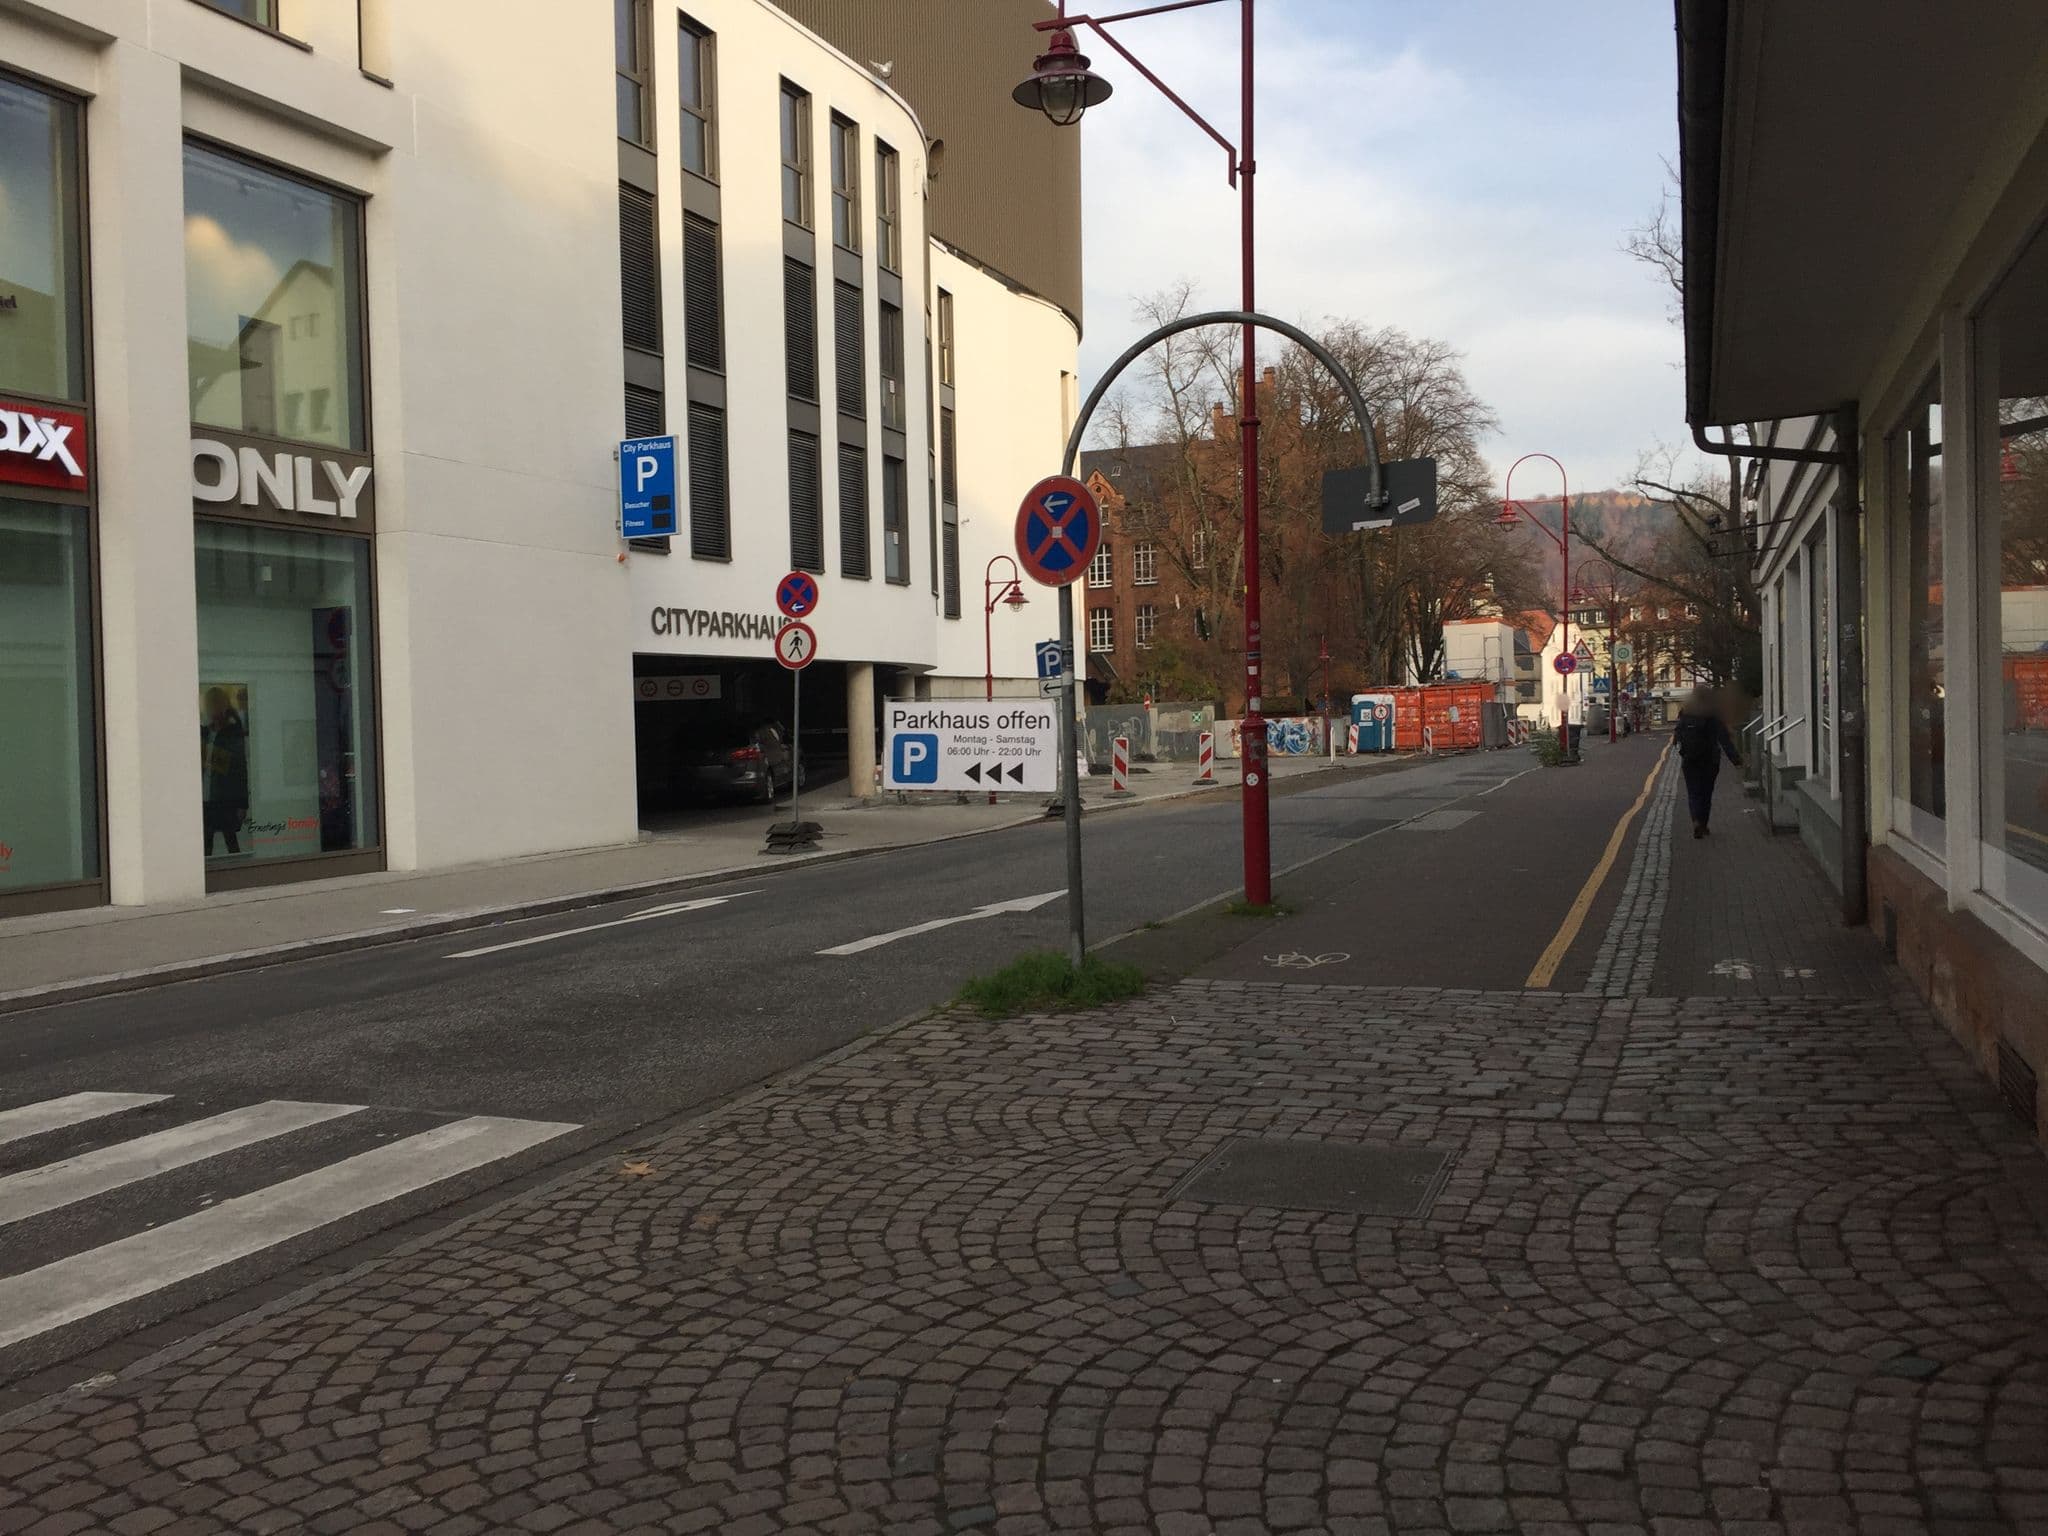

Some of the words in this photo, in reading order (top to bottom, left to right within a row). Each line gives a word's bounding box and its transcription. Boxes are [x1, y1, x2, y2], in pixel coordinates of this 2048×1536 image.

[623, 444, 637, 454] City
[638, 441, 671, 451] Parkhaus
[191, 438, 372, 518] ONLY
[637, 455, 658, 492] P
[1044, 650, 1060, 676] P
[893, 710, 989, 729] Parkhaus
[997, 710, 1050, 729] offen
[953, 735, 987, 745] Montag
[996, 735, 1036, 745] Samstag
[903, 741, 927, 776] P
[947, 747, 971, 756] 06:00
[974, 747, 989, 756] Uhr
[998, 747, 1023, 756] 22:00
[1025, 747, 1041, 756] Uhr
